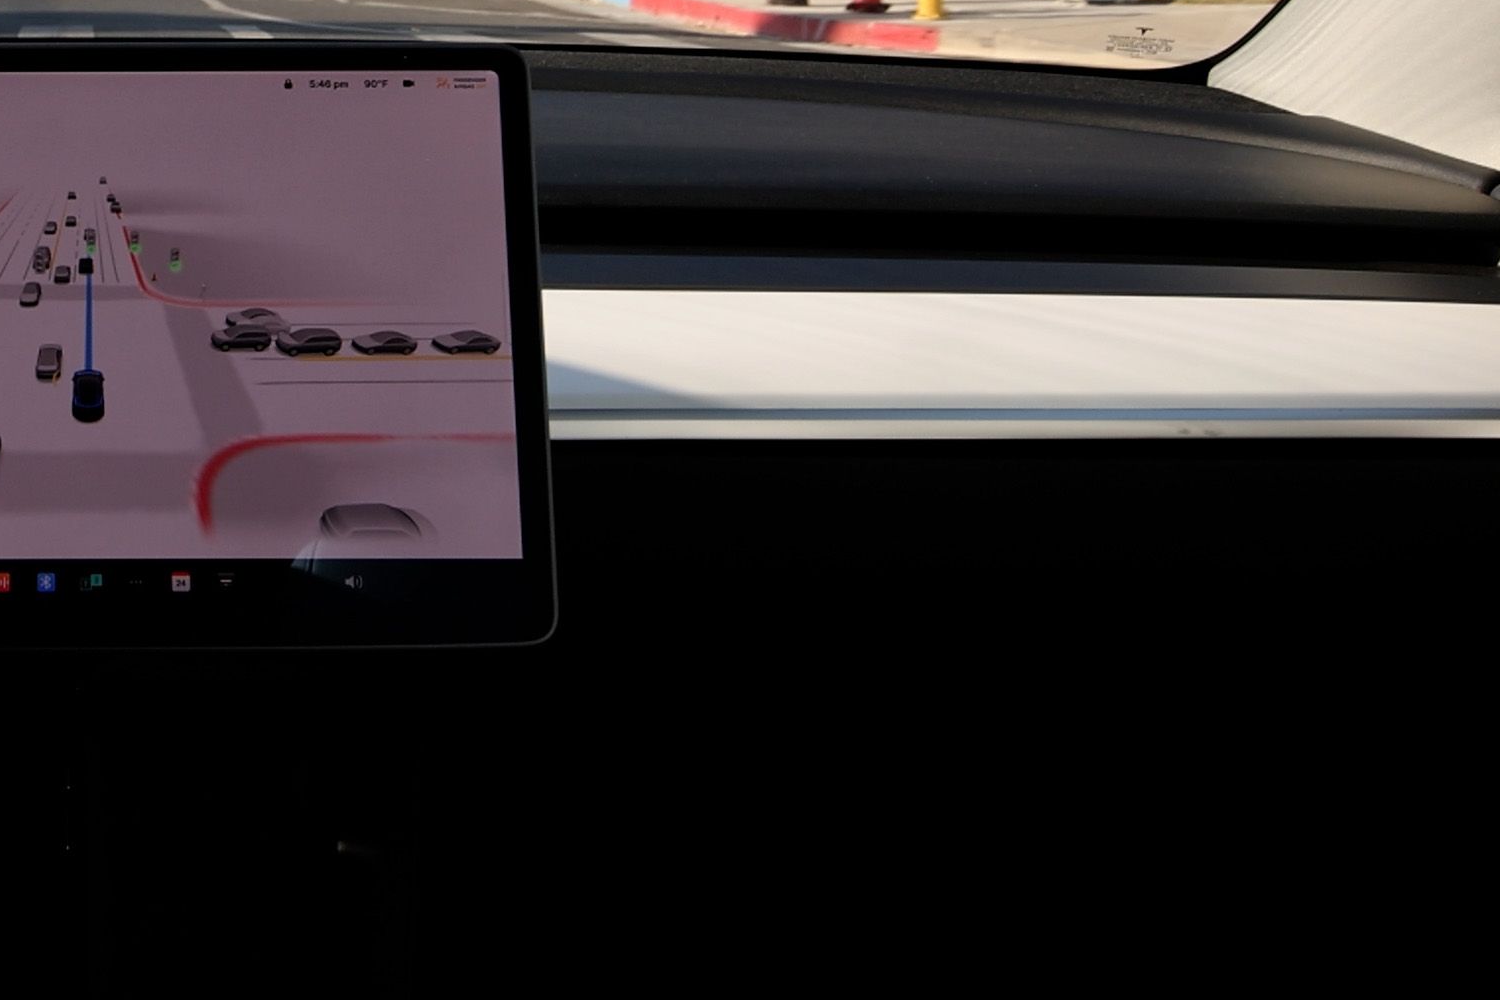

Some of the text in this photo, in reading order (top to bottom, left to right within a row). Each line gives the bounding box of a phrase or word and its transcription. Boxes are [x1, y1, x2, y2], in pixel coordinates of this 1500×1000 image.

[309, 80, 349, 90] 5:46 pm
[175, 579, 187, 587] 24
